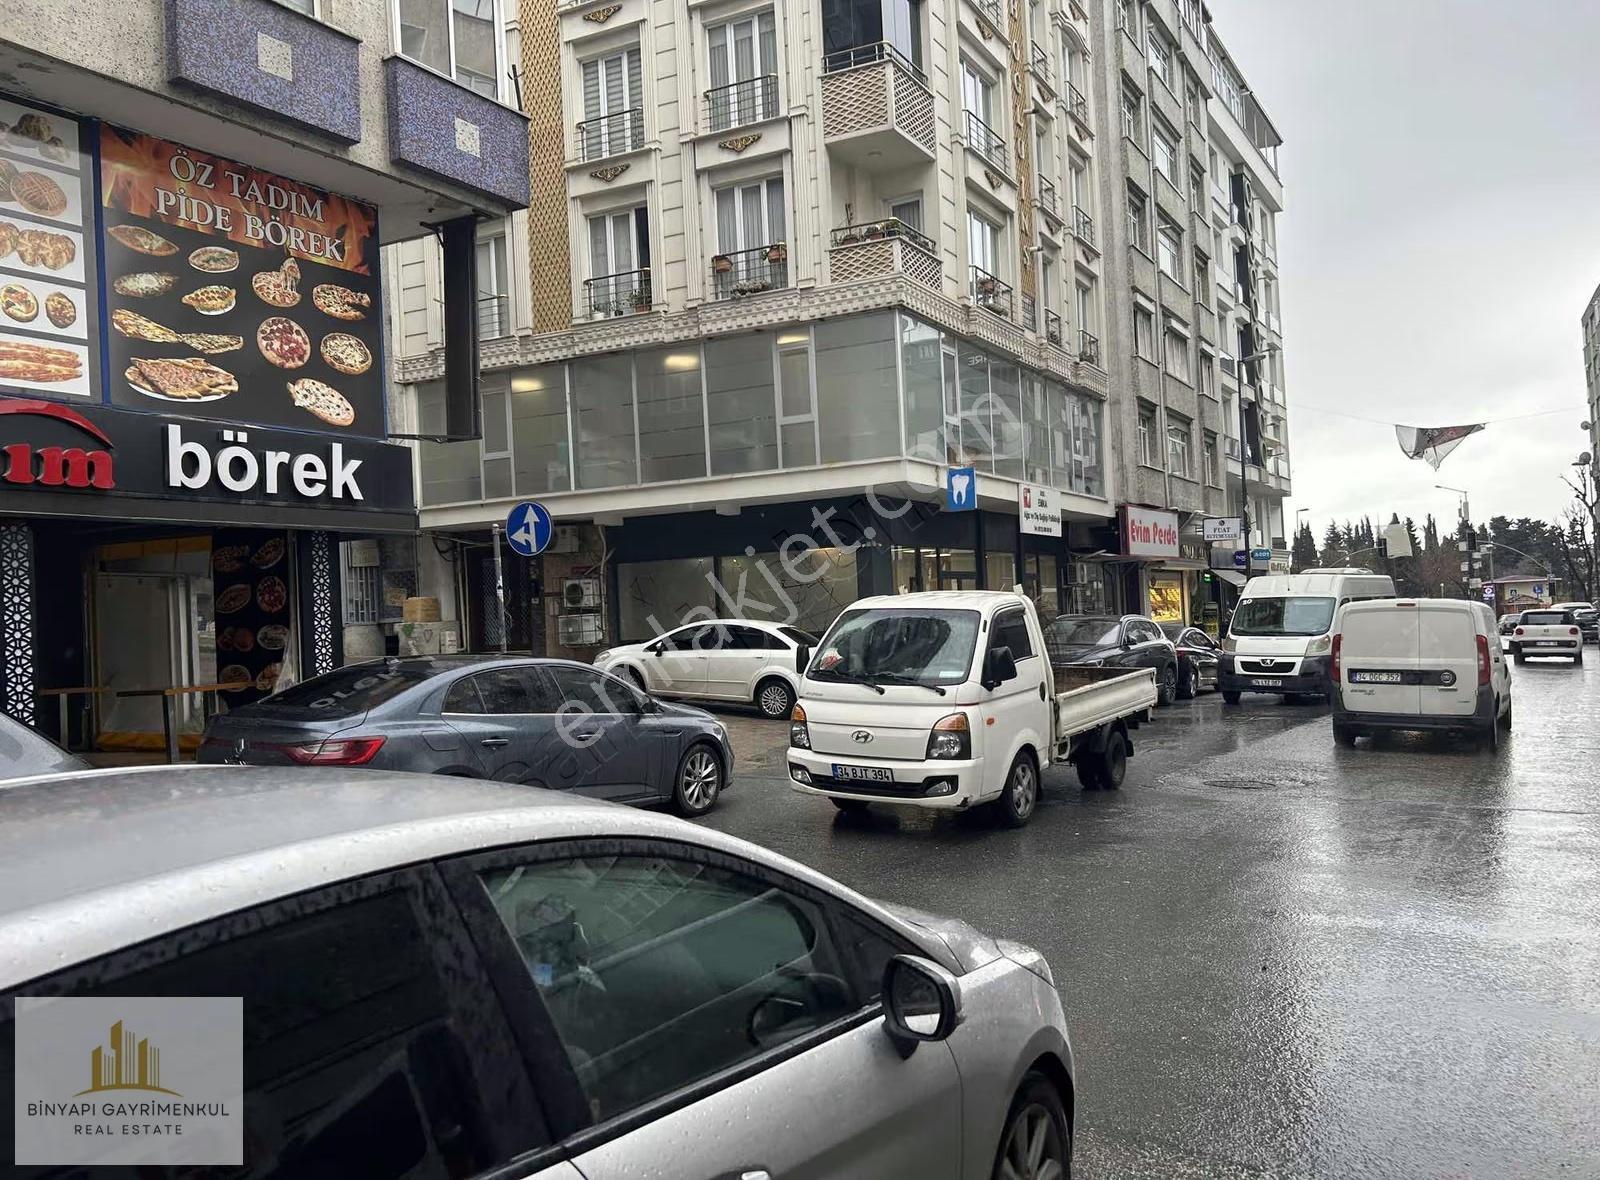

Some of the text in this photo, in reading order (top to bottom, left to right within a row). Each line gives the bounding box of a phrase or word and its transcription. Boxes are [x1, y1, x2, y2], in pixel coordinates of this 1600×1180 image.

[169, 149, 325, 222] ÖZ TADIM
[155, 187, 344, 262] PİDE BÖREK
[167, 423, 365, 500] börek
[1130, 519, 1177, 546] Evim Perde
[838, 767, 890, 781] 34 BJT 394
